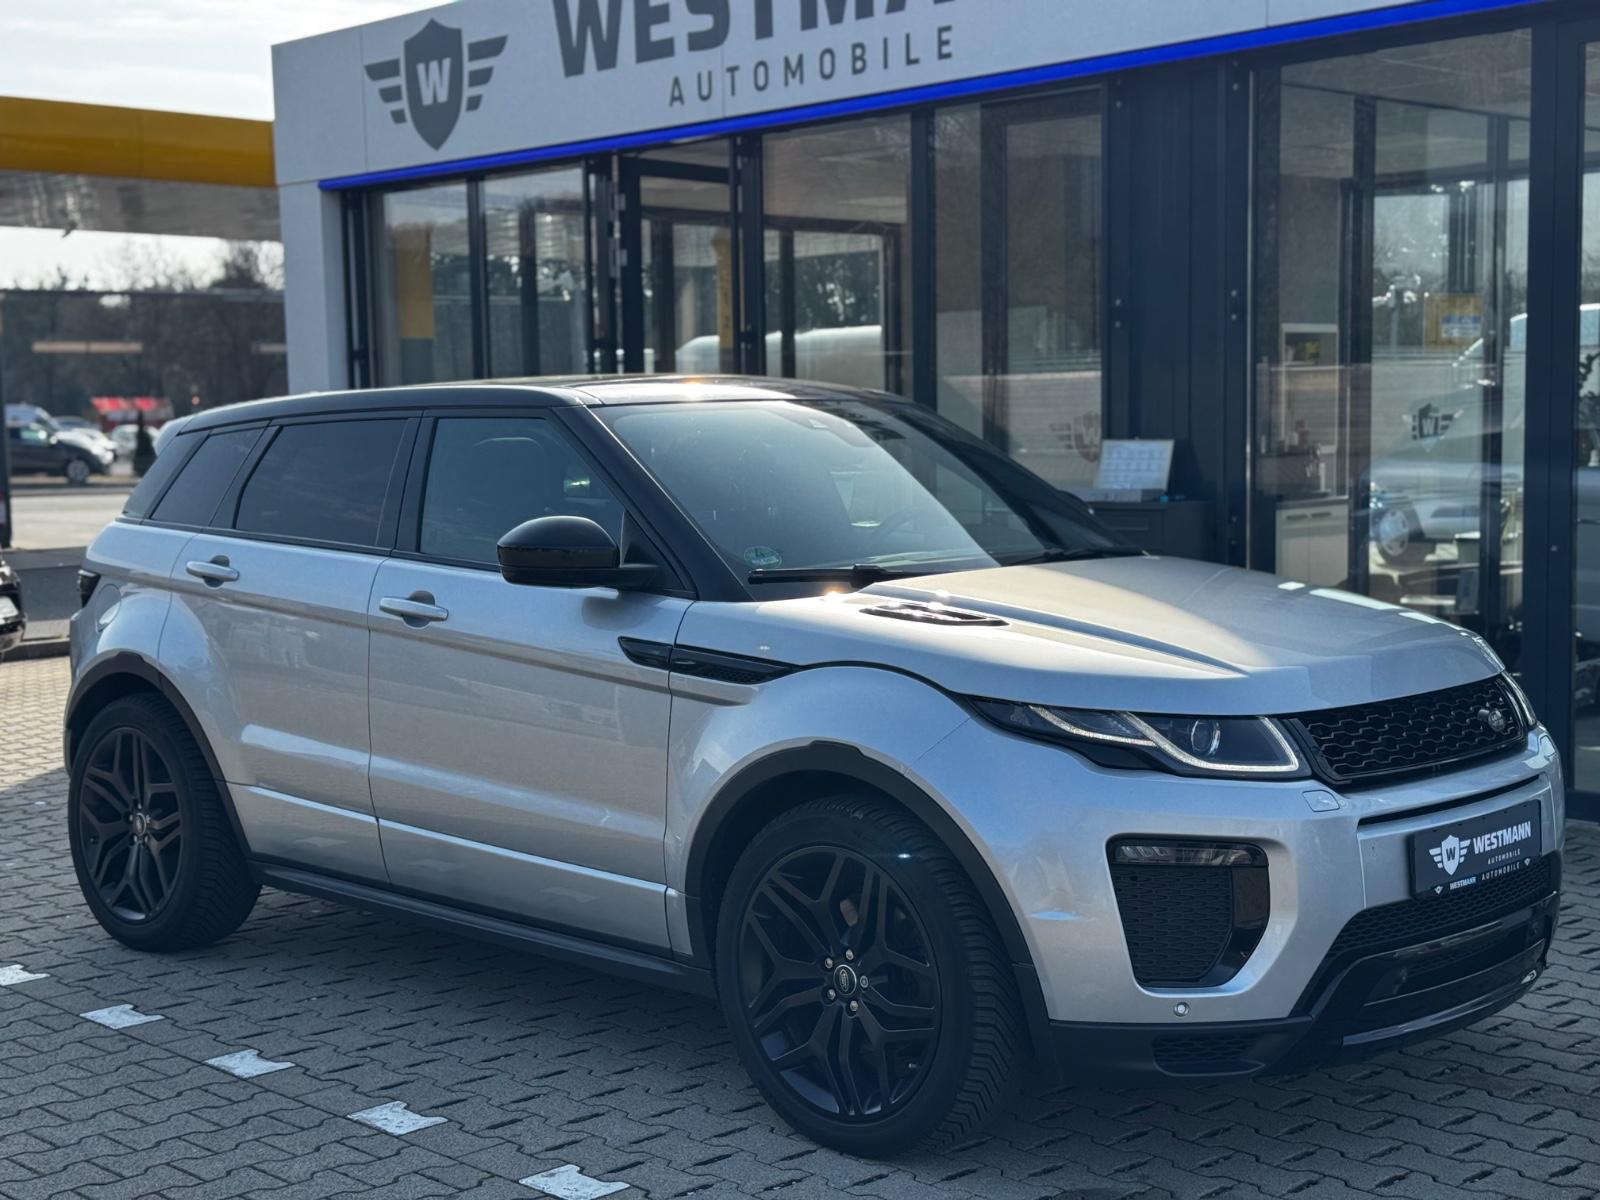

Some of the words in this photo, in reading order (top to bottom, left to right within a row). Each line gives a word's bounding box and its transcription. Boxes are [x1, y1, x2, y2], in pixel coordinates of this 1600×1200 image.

[669, 25, 953, 107] AUTOMOBILE
[416, 57, 451, 106] W
[1473, 821, 1531, 854] WESTMANN
[1446, 846, 1456, 861] W
[1487, 848, 1521, 865] AUTOMOBILE
[1481, 862, 1521, 880] AUTOMOBILE
